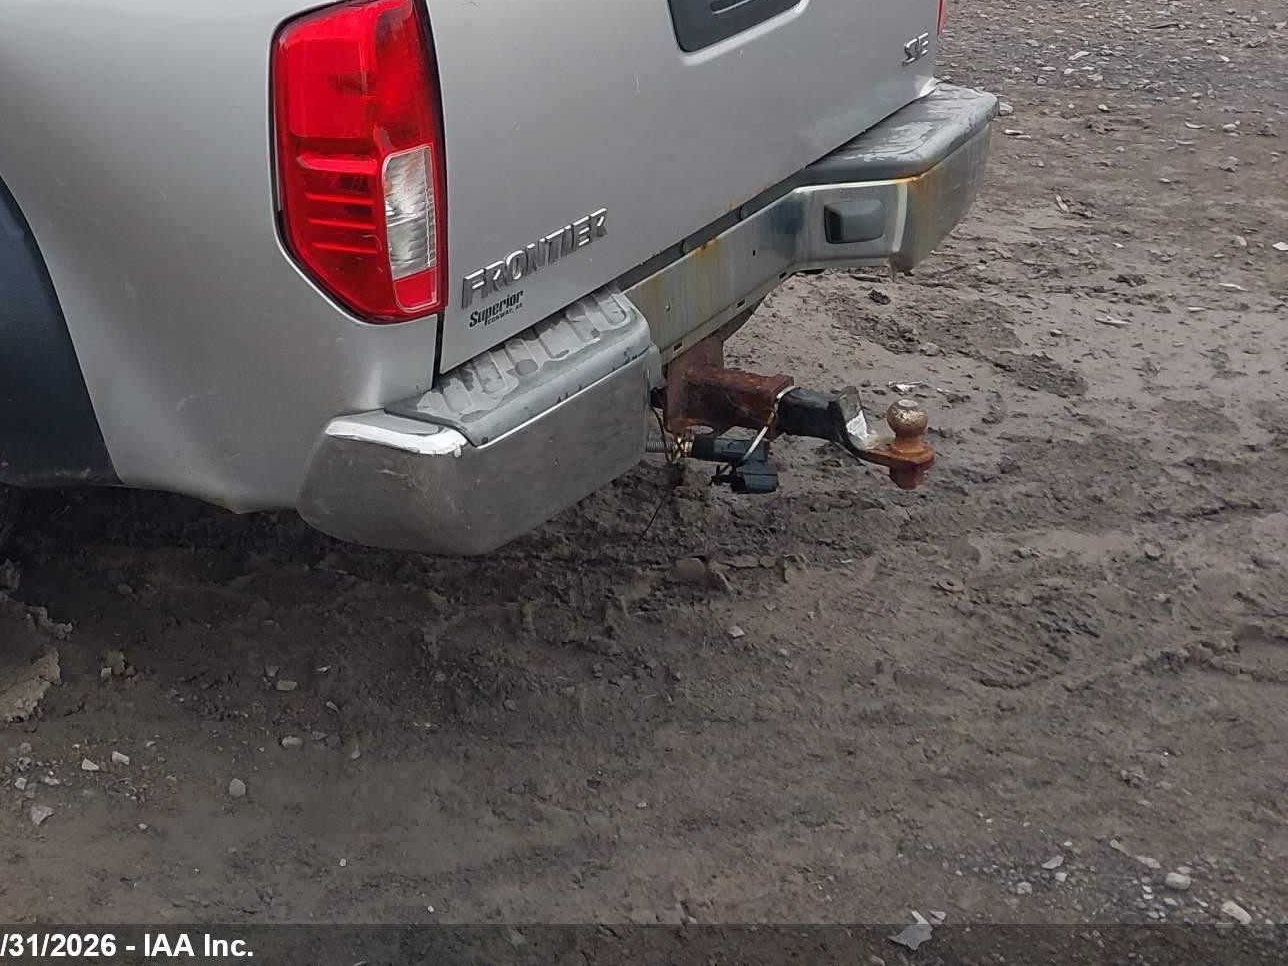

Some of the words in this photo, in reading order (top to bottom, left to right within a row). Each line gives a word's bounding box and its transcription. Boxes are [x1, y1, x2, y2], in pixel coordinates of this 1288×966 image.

[902, 32, 929, 67] SE
[461, 207, 608, 309] FRONTIER
[469, 290, 524, 327] Superior
